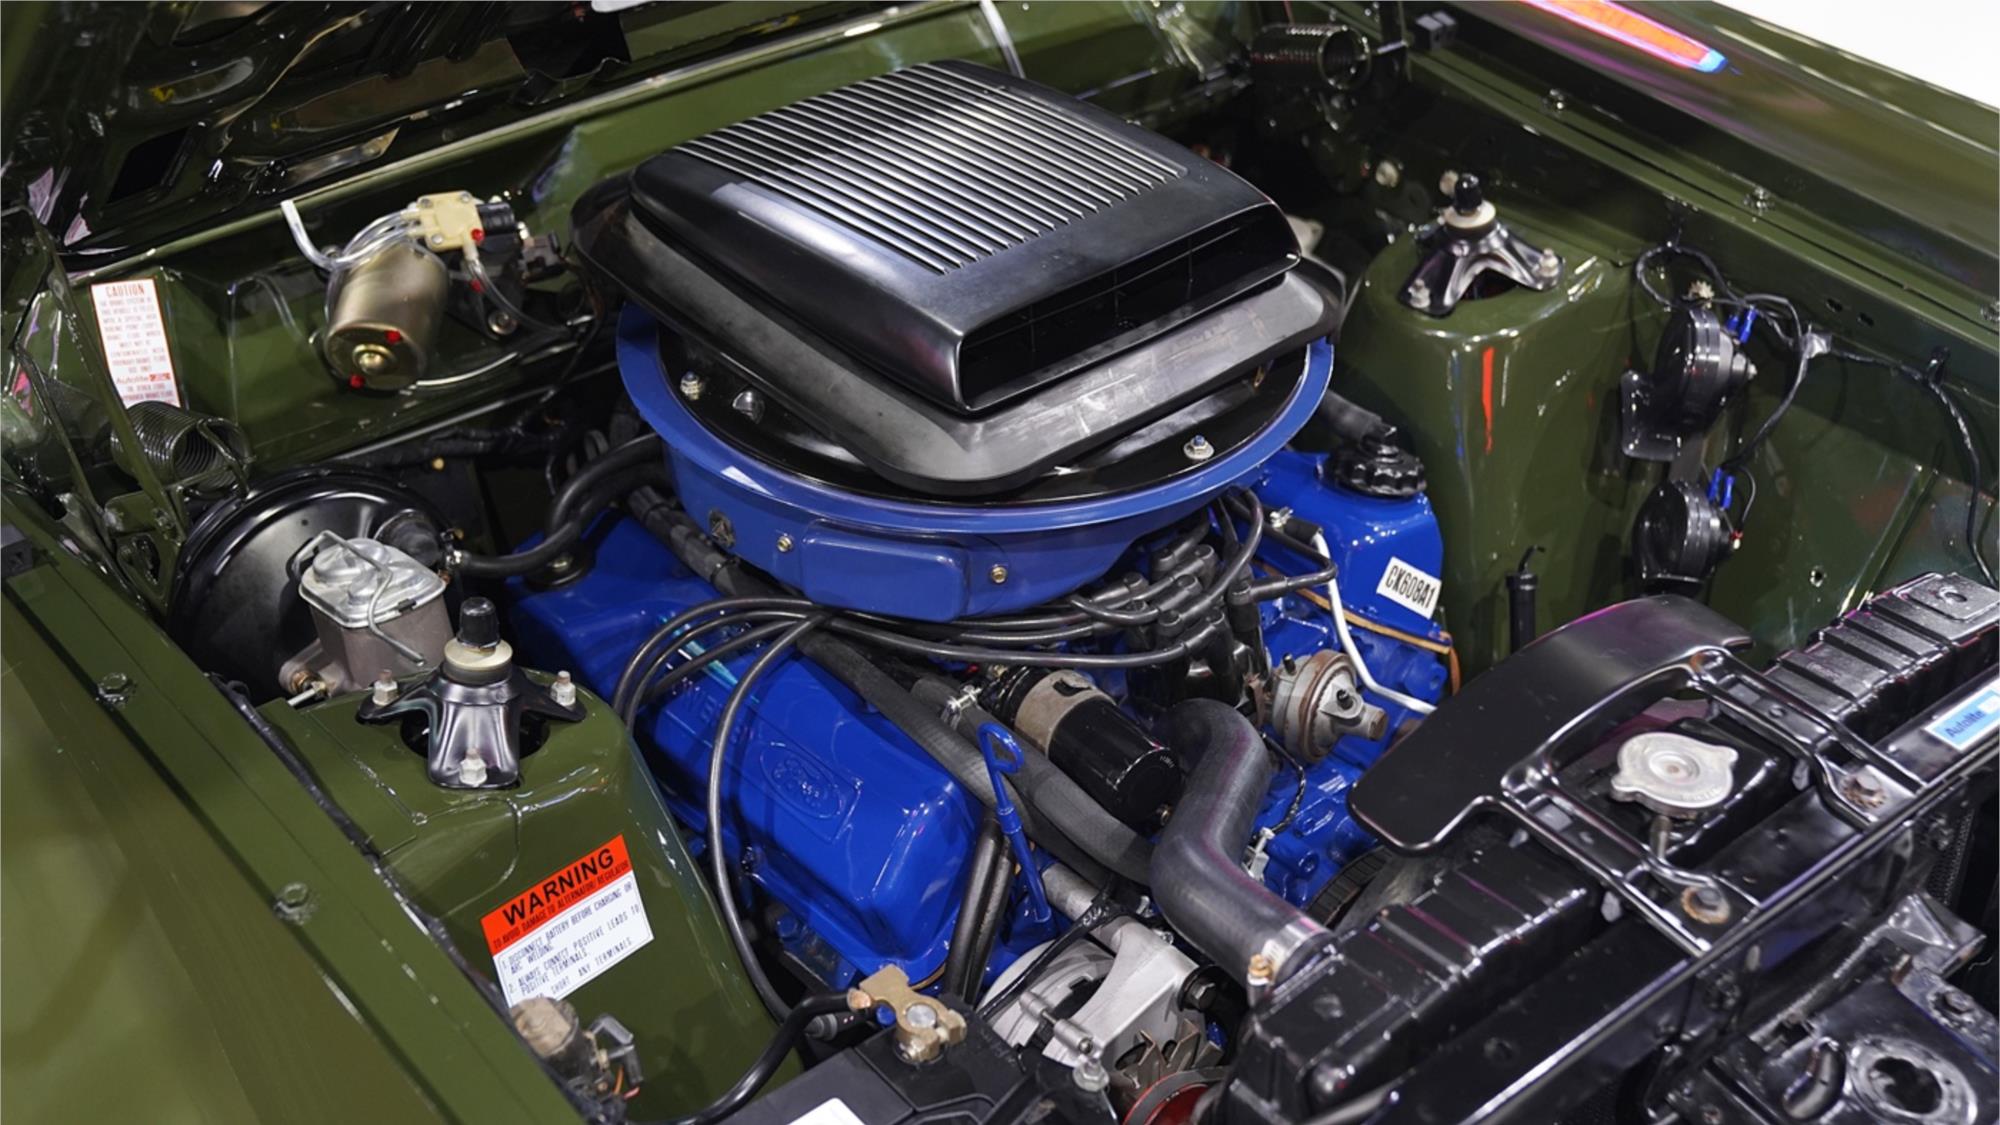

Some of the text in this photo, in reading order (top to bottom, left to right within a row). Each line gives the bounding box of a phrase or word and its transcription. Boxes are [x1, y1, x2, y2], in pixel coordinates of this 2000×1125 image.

[105, 283, 145, 298] CAUTION
[502, 848, 614, 926] WARNING
[521, 909, 547, 932] DAMAGE
[545, 920, 570, 941] BATTERY
[570, 906, 593, 925] BEFORE
[594, 888, 622, 911] CHARGING
[543, 947, 569, 971] CONNECT
[573, 926, 604, 949] POSITIVE
[607, 911, 628, 931] LEADS
[595, 937, 632, 967] TERMINALS
[521, 948, 588, 996] POSITIVE TERMINALS
